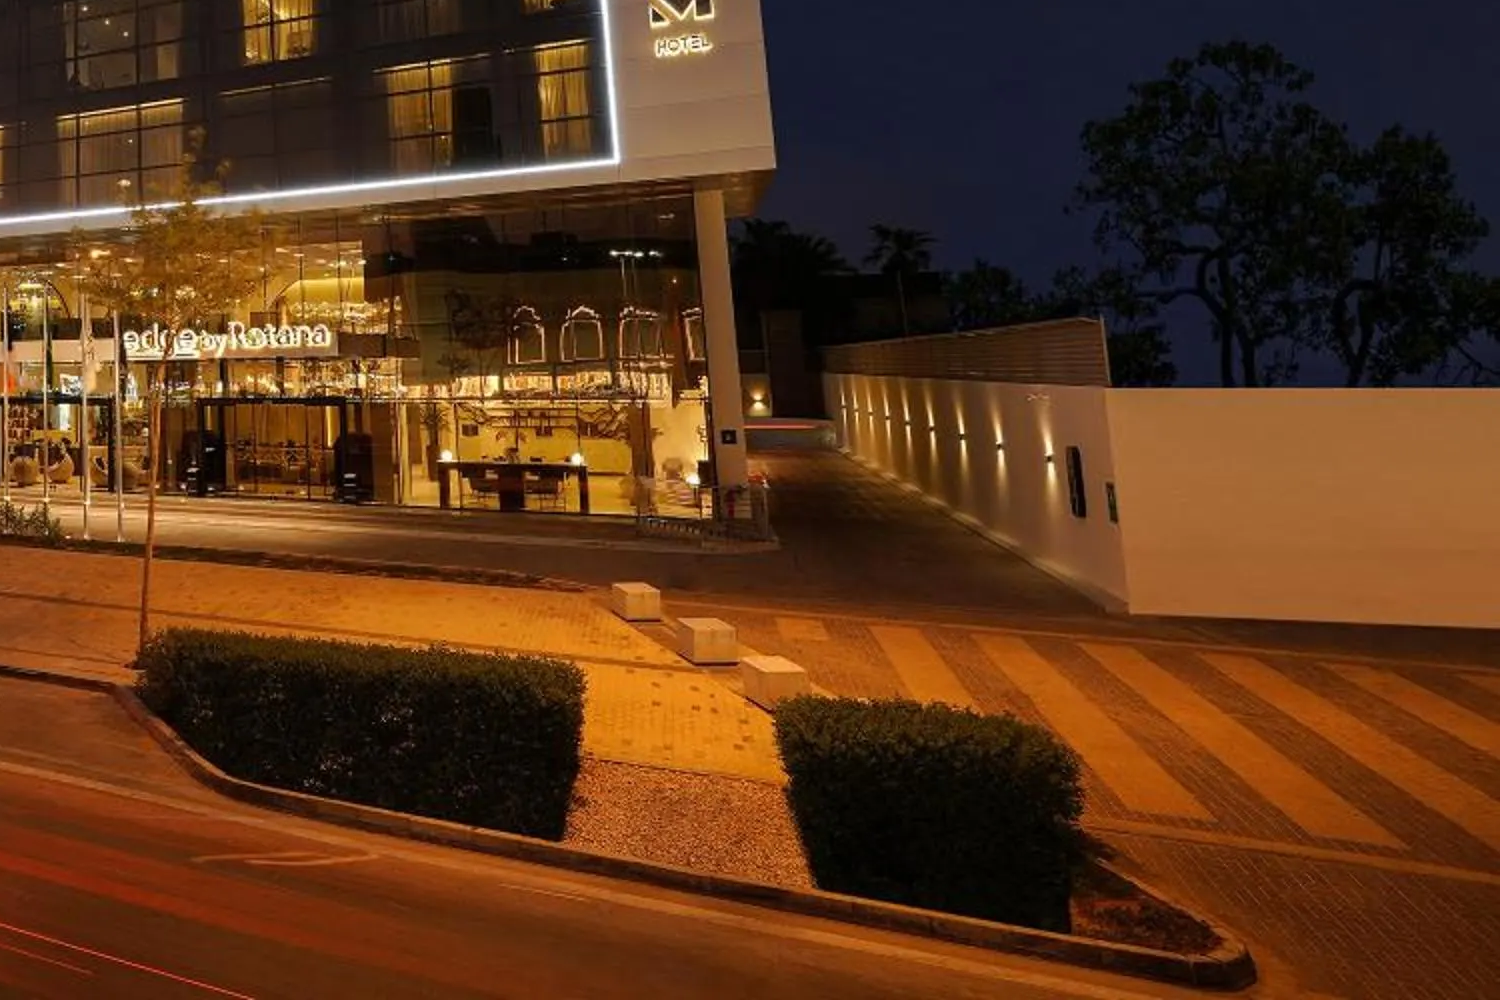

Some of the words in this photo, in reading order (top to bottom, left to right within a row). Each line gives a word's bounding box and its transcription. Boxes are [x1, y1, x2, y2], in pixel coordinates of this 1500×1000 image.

[654, 33, 713, 57] HOTEL
[200, 329, 228, 357] by
[227, 320, 332, 350] Rotana
